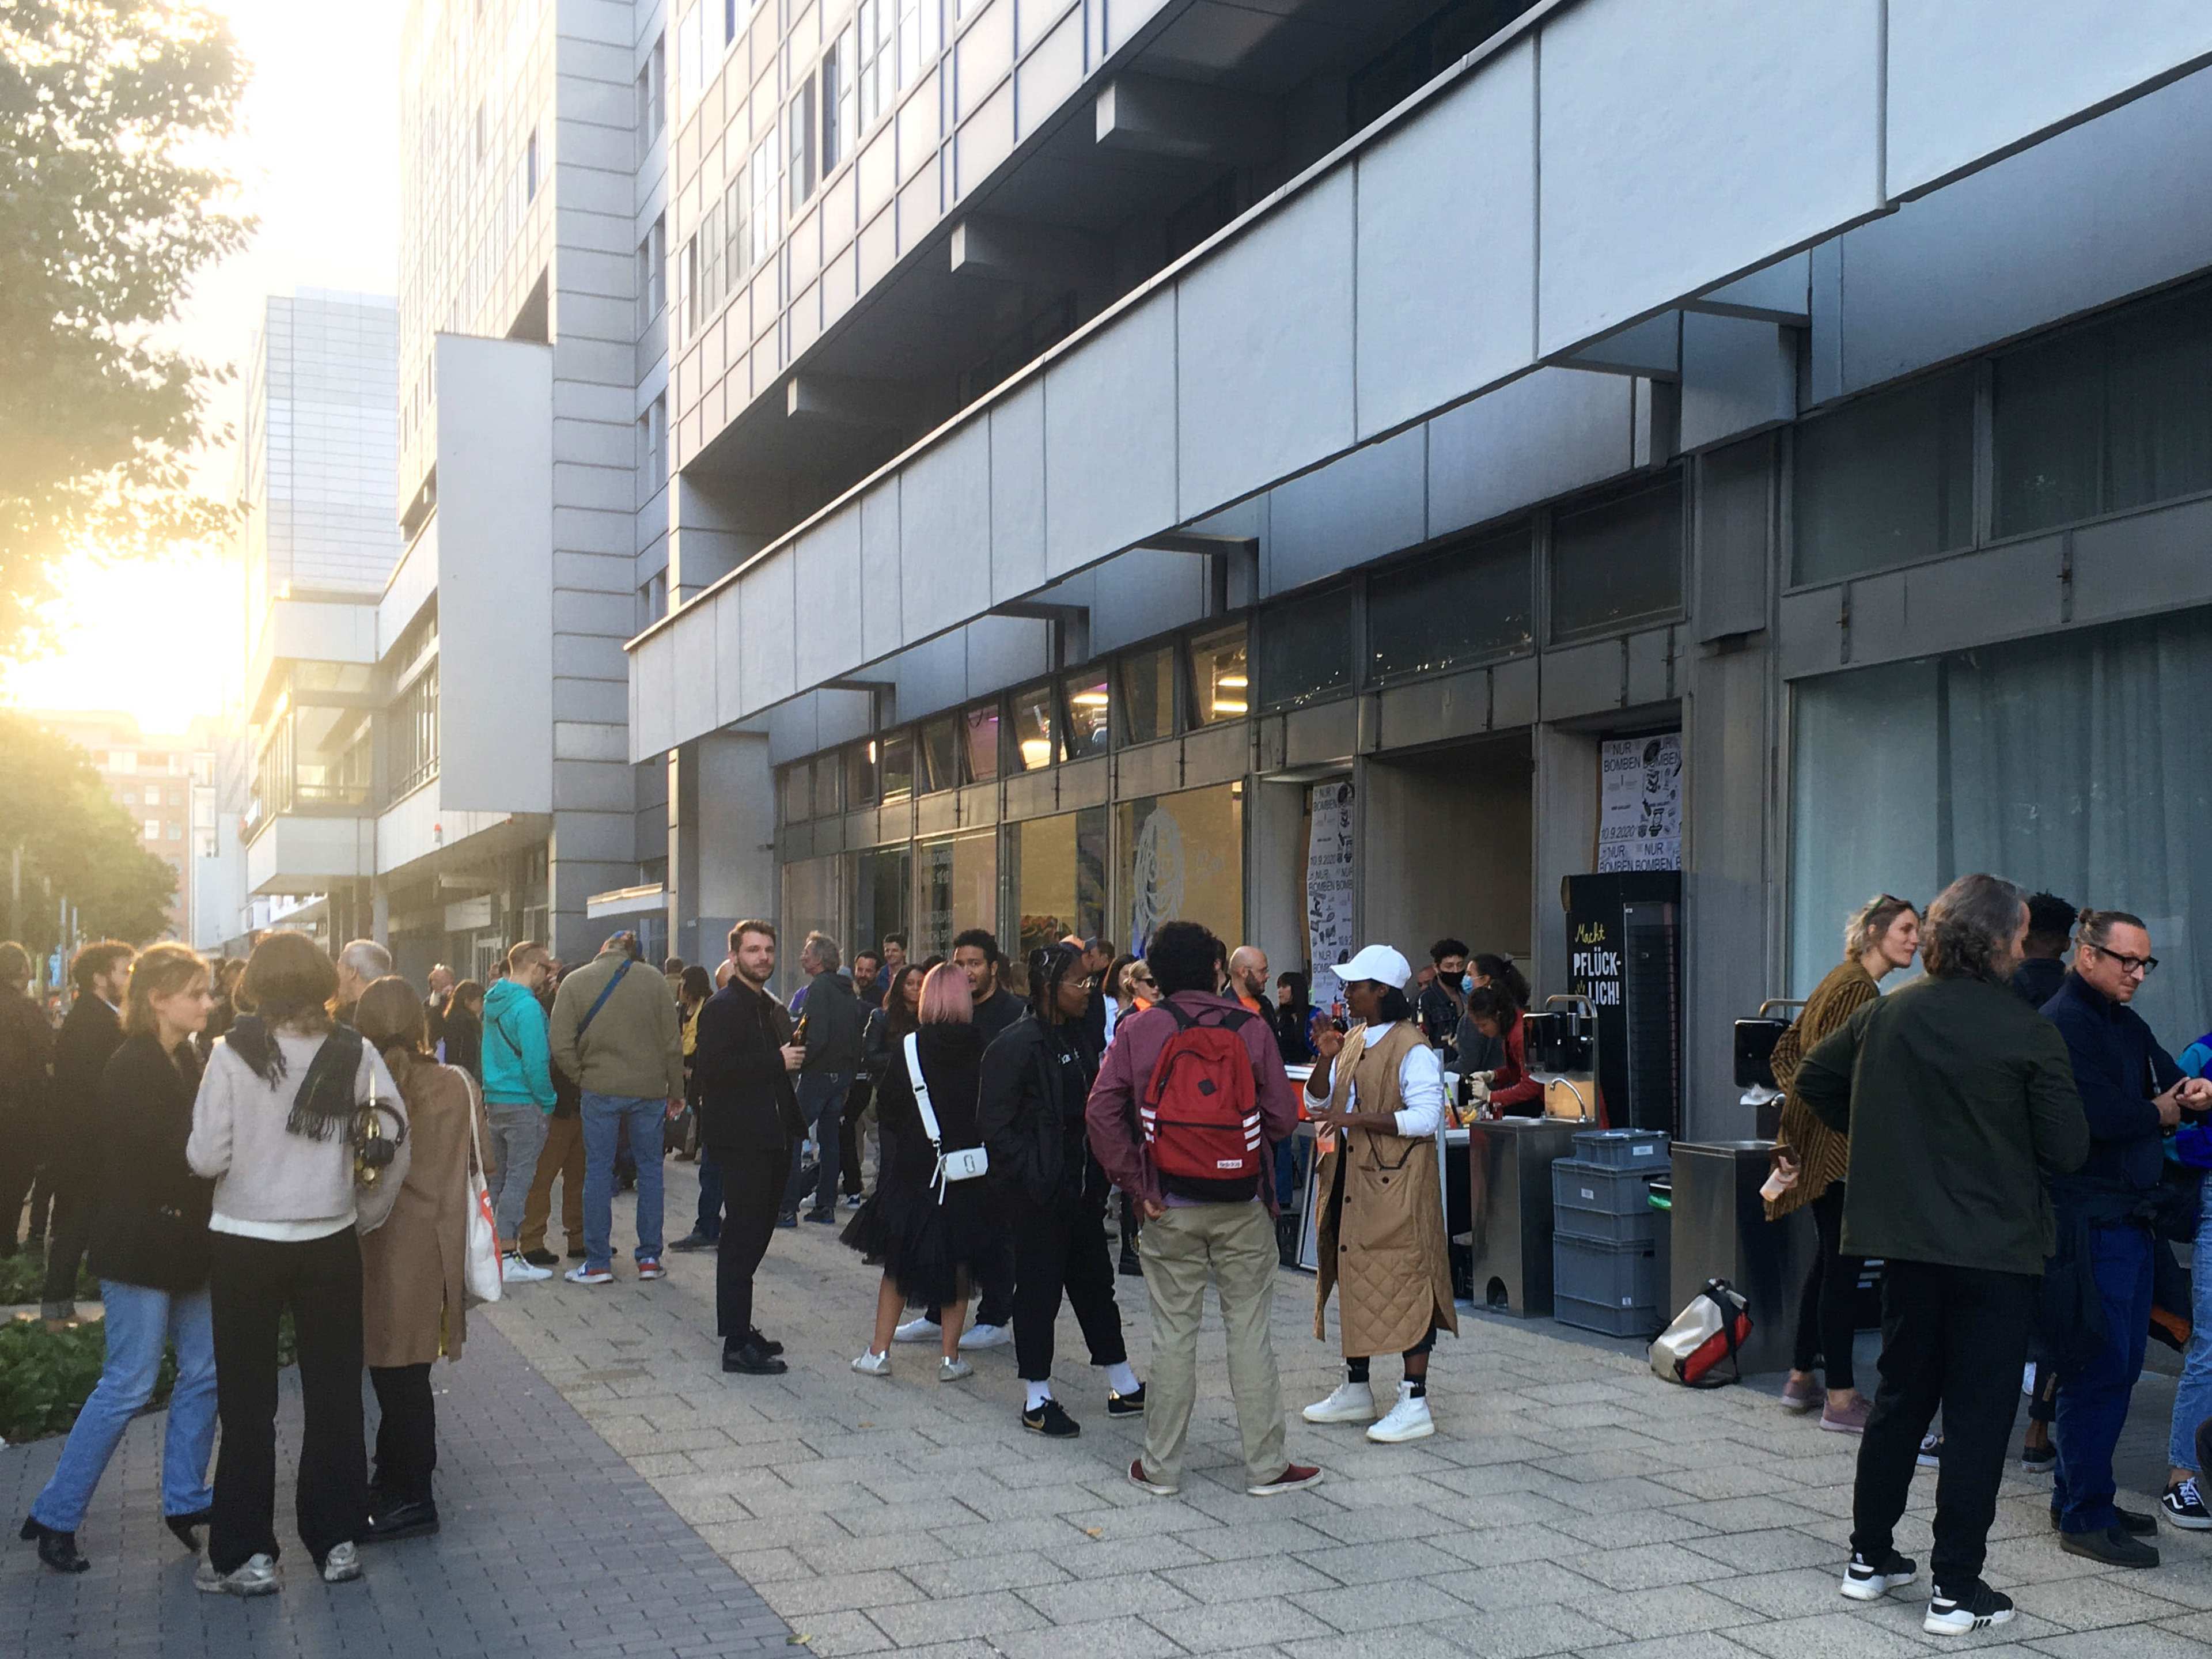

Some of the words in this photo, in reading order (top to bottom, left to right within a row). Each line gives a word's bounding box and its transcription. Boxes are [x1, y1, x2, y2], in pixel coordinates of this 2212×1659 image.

[1613, 741, 1631, 755] NUR
[1604, 756, 1641, 772] BOMBEN
[1608, 845, 1624, 858] NUR
[1645, 842, 1663, 855] NUR
[1575, 922, 1606, 944] Macht
[1574, 946, 1622, 976] PFLÜCK-
[1588, 981, 1620, 1005] LICH!
